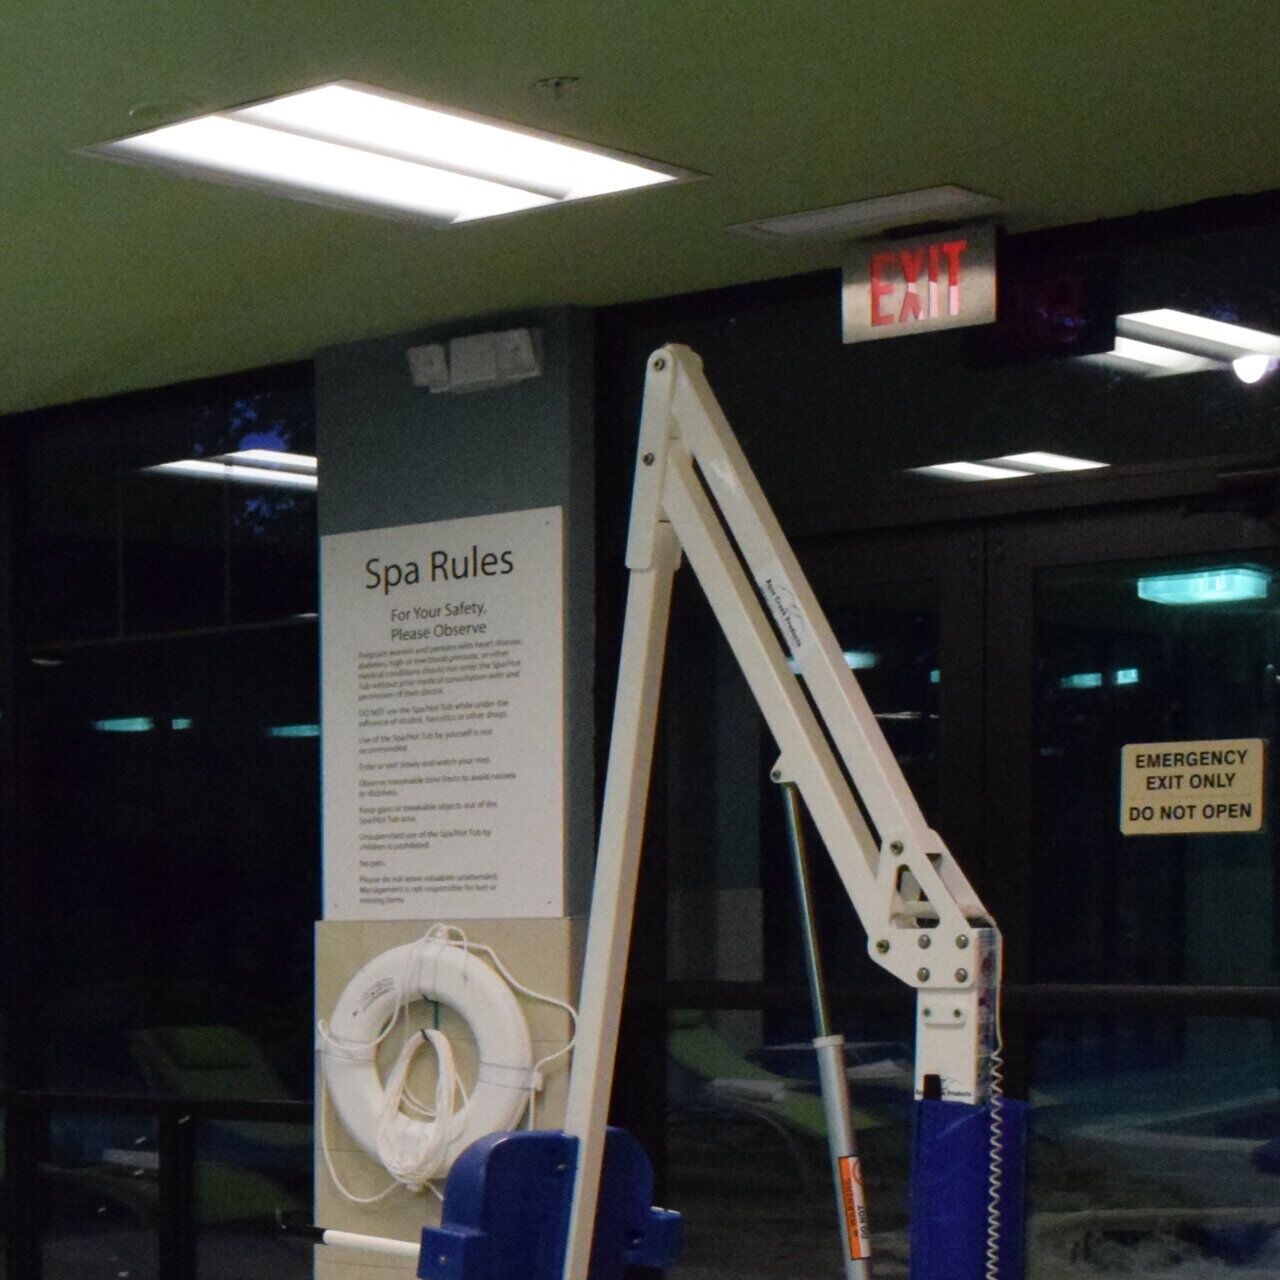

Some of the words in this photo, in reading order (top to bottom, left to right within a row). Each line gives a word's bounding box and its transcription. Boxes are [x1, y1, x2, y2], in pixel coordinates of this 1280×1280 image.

[870, 239, 967, 327] EXIT
[365, 557, 420, 596] Spa
[431, 544, 514, 582] Rules
[391, 608, 411, 622] For
[413, 604, 441, 620] Your
[391, 627, 431, 641] Please
[433, 621, 487, 638] Observe
[1135, 749, 1248, 769] EMERGENCY
[1146, 775, 1184, 790] EXIT
[1189, 772, 1236, 789] ONLY
[1129, 805, 1154, 821] DO
[1160, 804, 1197, 820] NOT
[1202, 802, 1252, 819] OPEN
